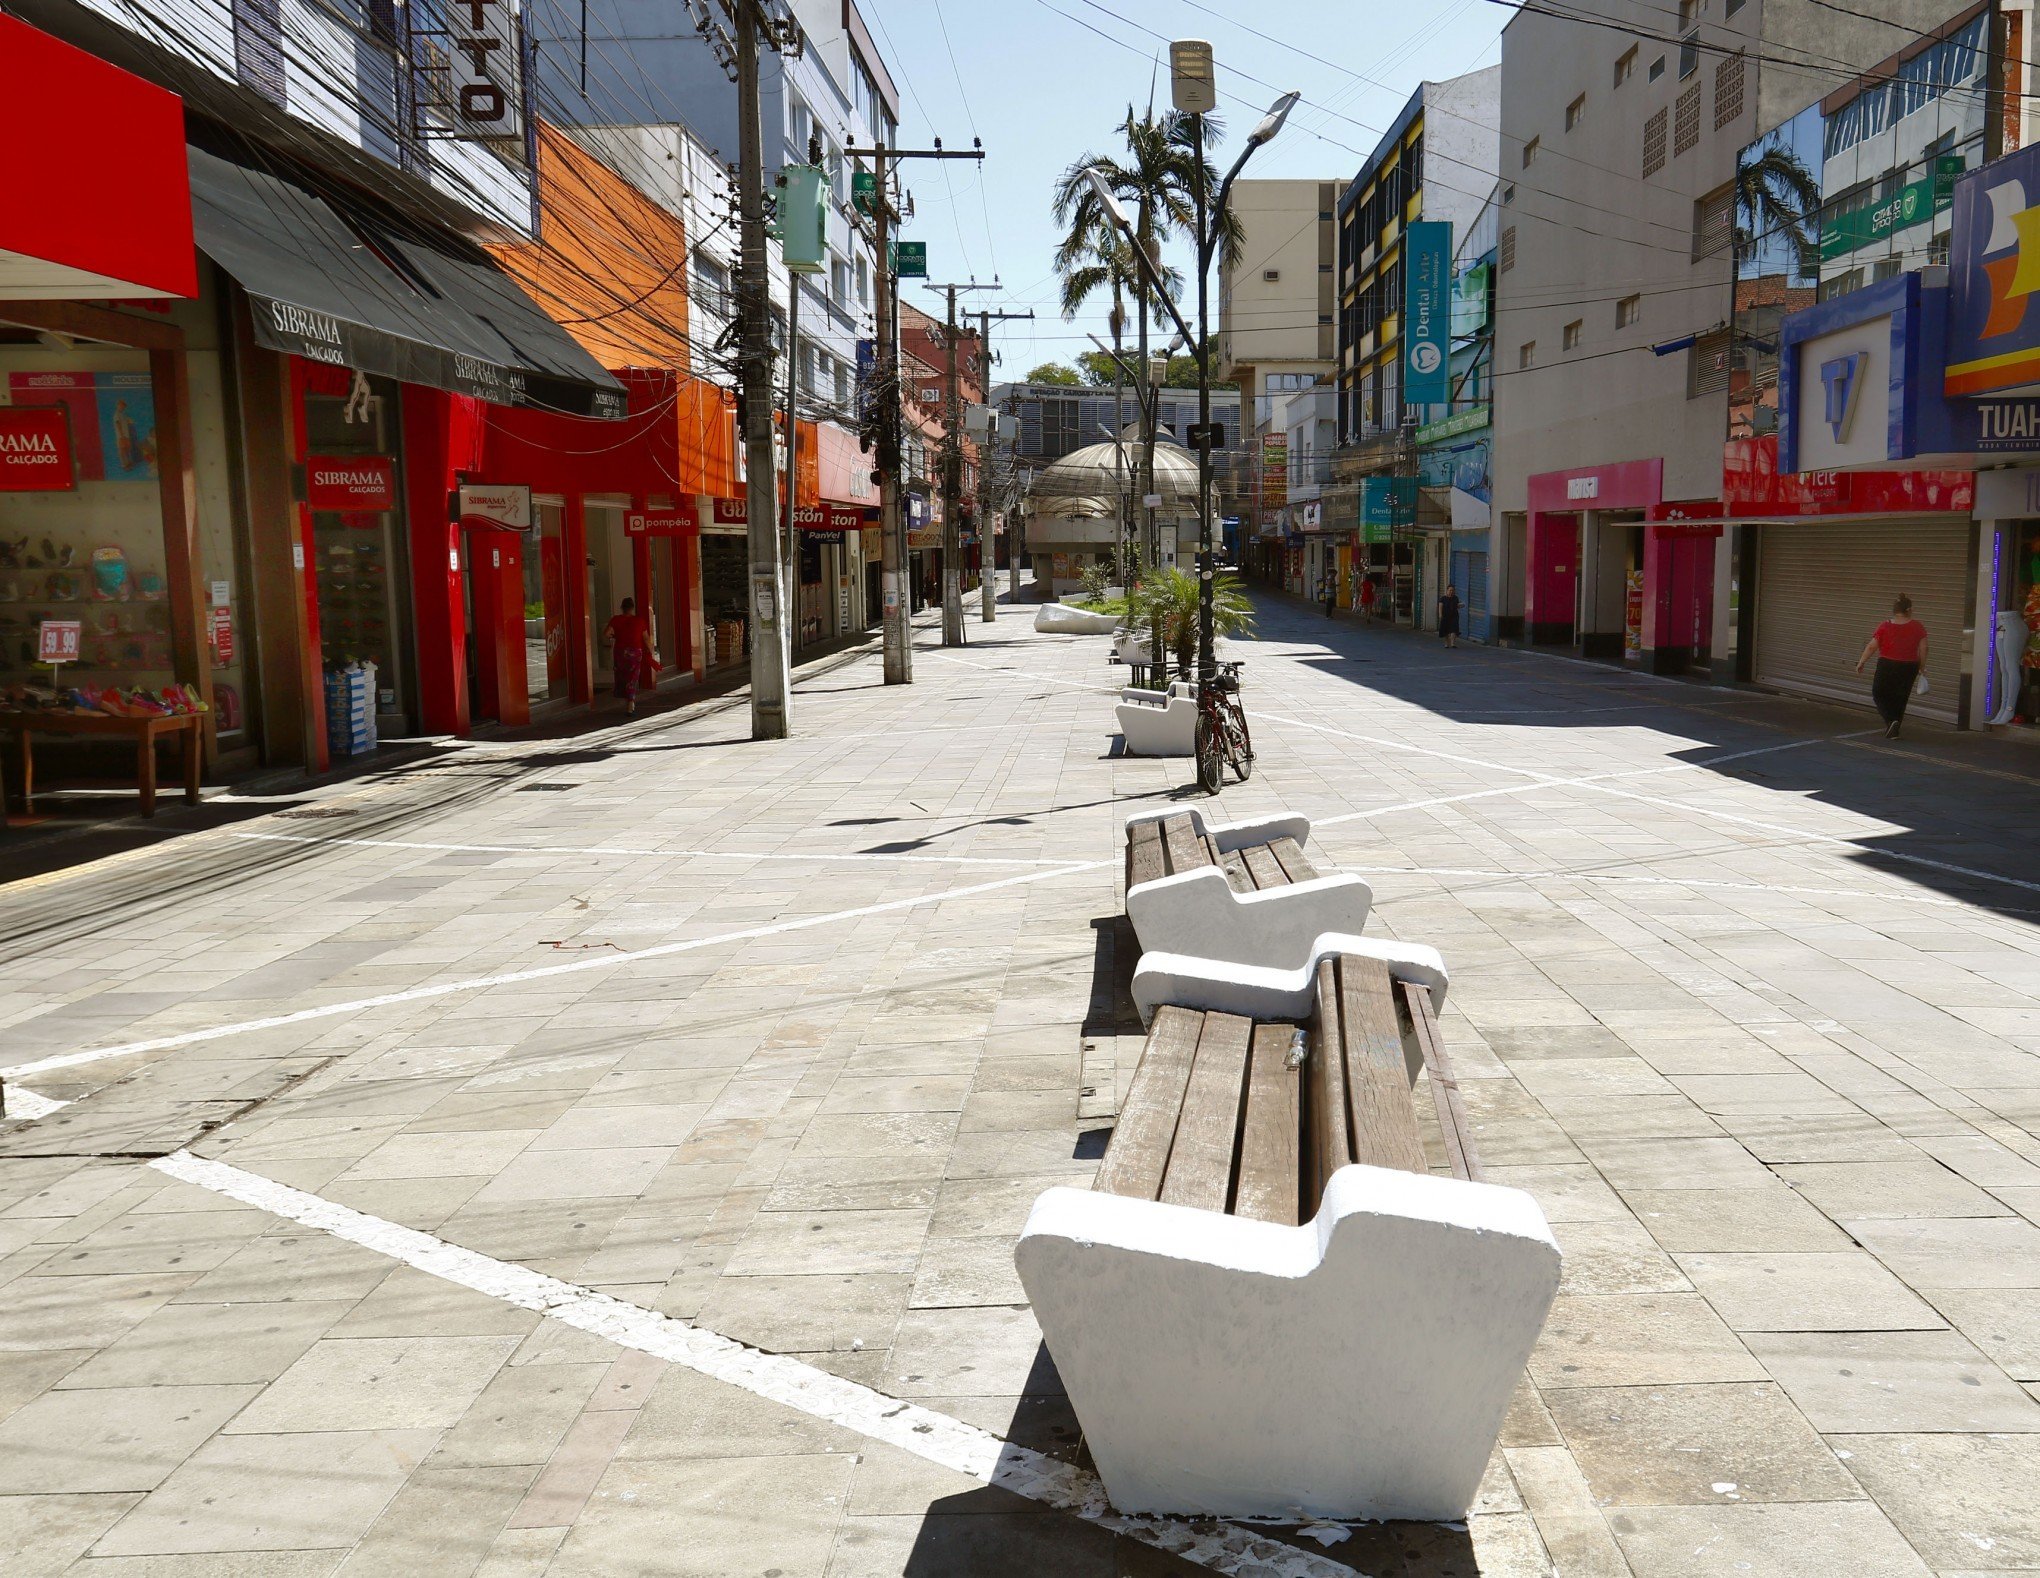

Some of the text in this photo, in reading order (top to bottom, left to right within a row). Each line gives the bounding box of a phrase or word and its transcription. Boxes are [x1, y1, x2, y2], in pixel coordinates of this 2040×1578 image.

[1417, 288, 1430, 337] Dental
[271, 301, 342, 345] SIBRAMA
[6, 455, 58, 465] CALÇADOS
[314, 471, 384, 485] SIBRAMA
[348, 486, 386, 494] CALÇADOS
[1567, 477, 1598, 499] marisa
[468, 496, 506, 505] SIBRAMA
[646, 518, 691, 529] pompéia
[62, 632, 76, 653] 99
